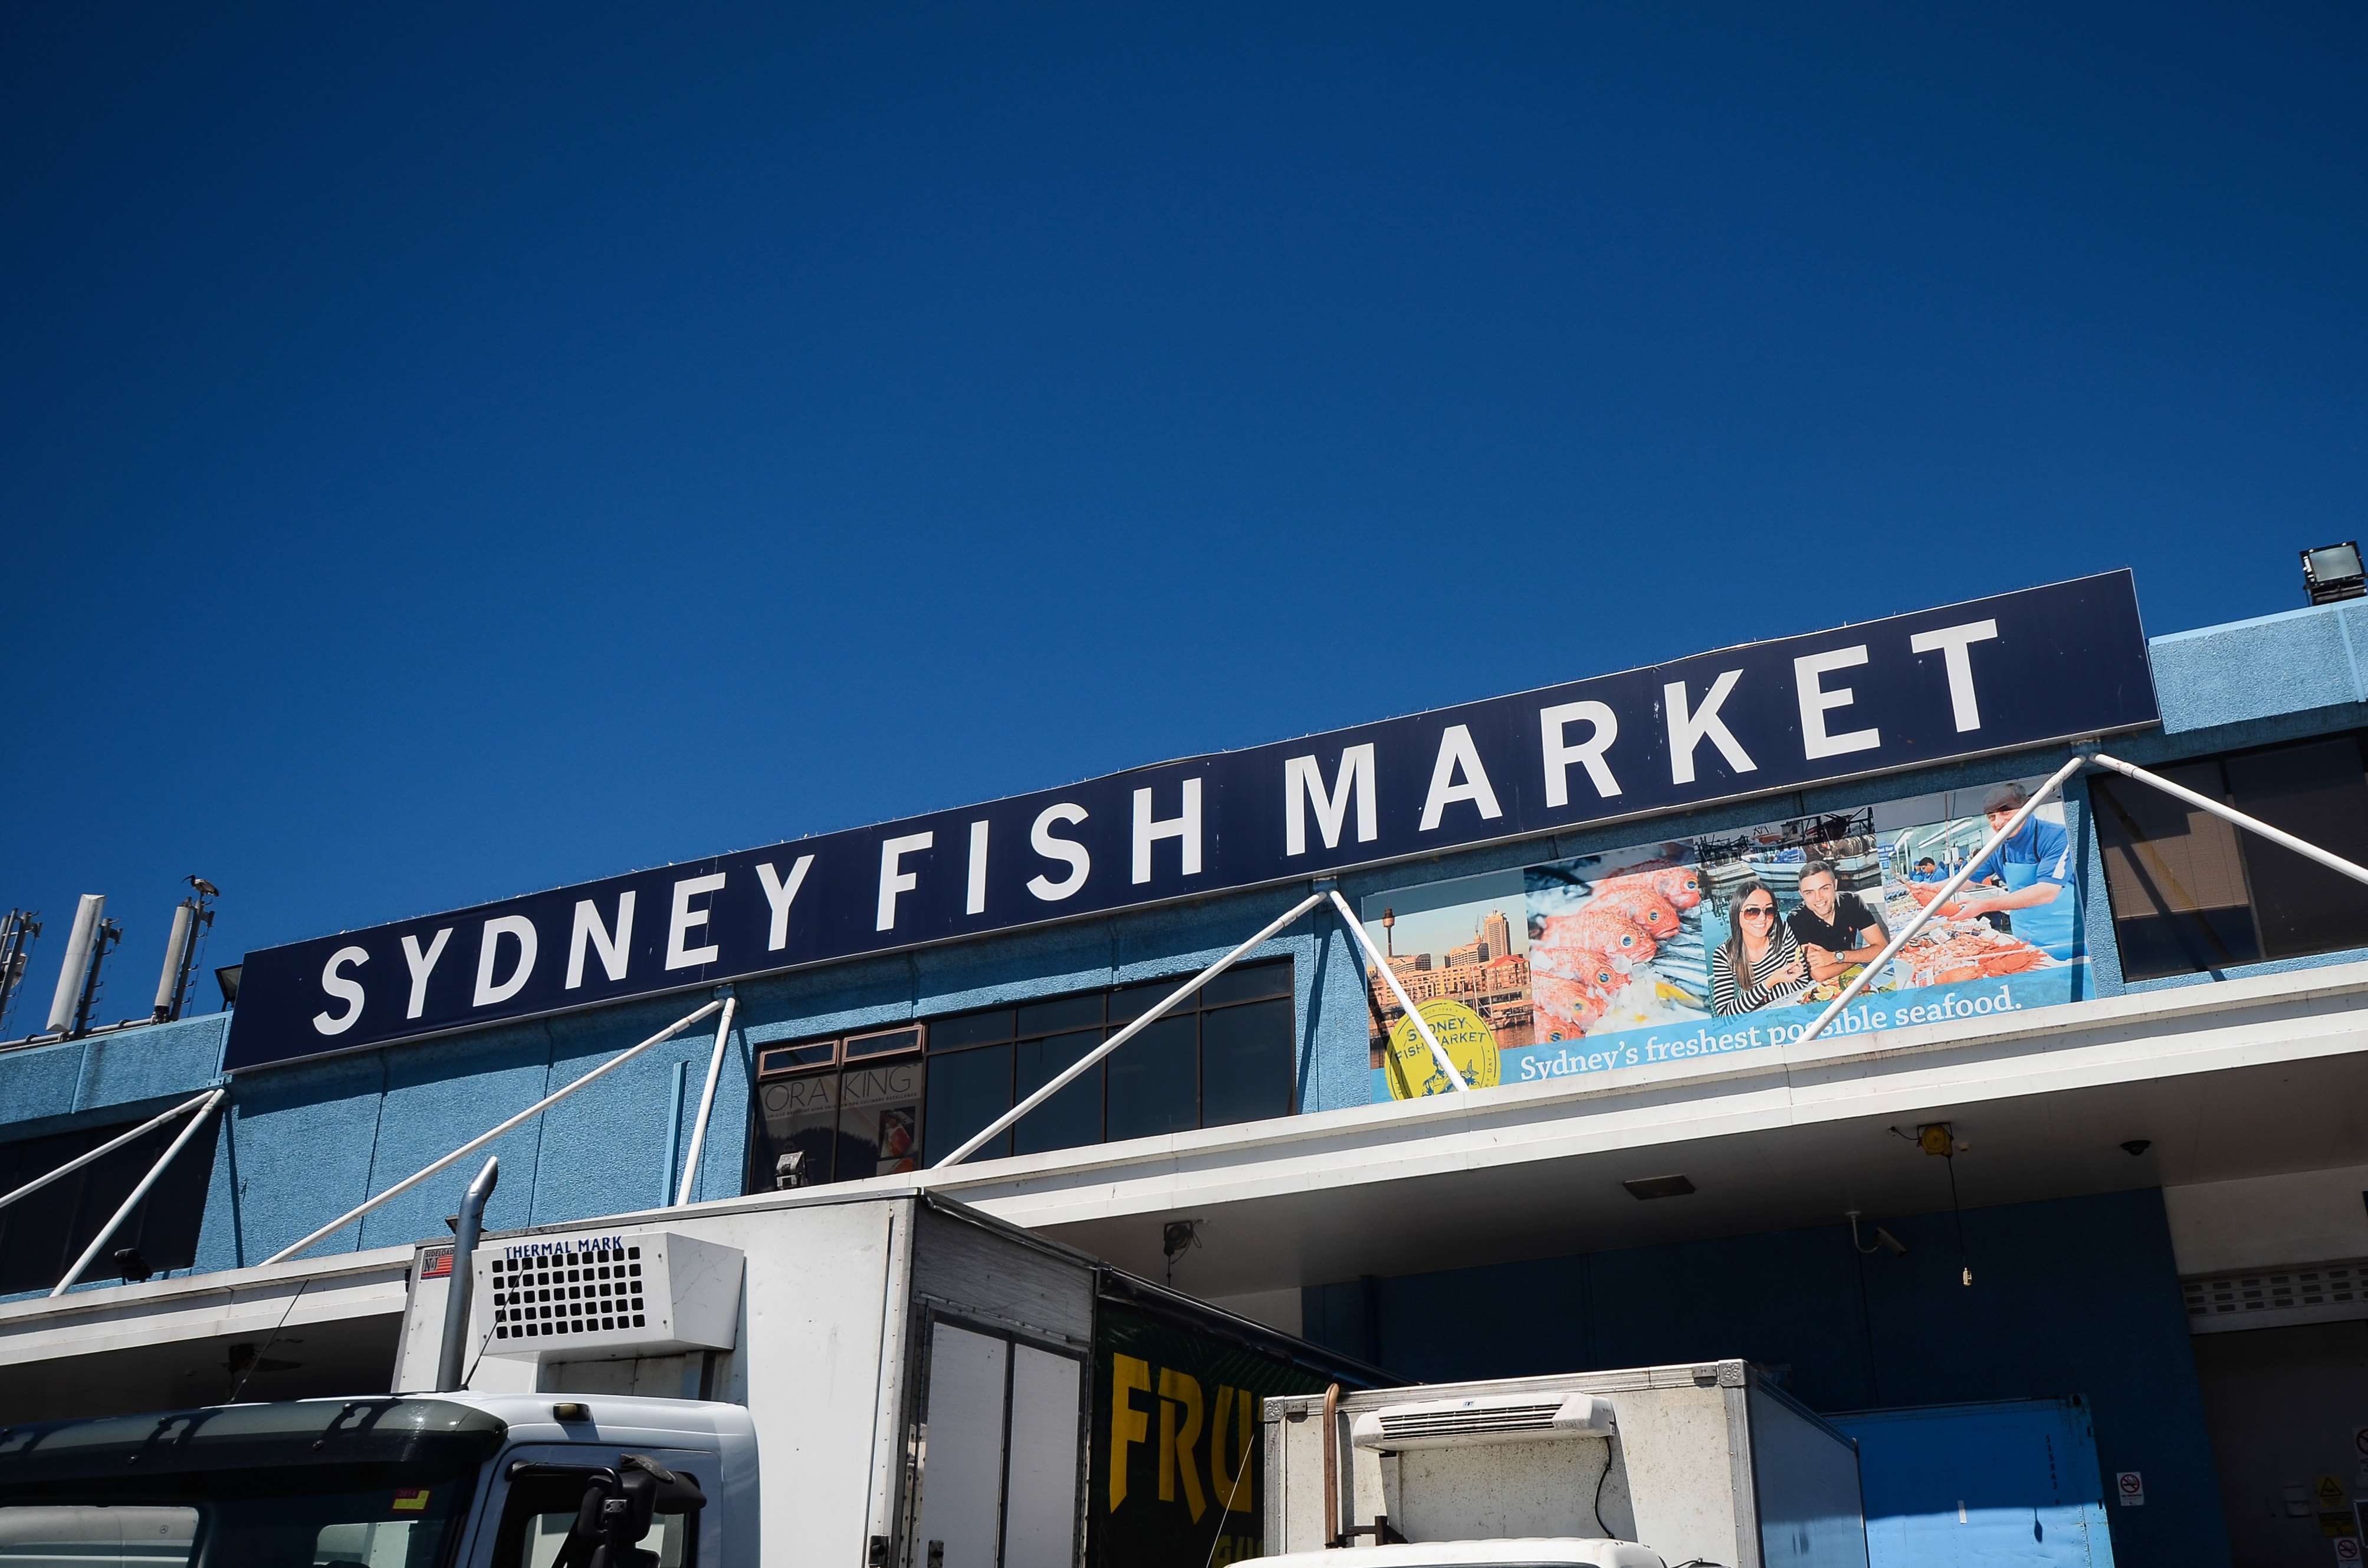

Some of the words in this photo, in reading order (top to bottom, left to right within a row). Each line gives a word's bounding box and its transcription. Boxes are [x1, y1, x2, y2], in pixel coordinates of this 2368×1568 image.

[313, 854, 816, 1036] SYDNEY
[876, 777, 1202, 931] FISH
[1285, 618, 1998, 856] MARKET
[1407, 1017, 1466, 1041] SDNEY
[1436, 1032, 1486, 1046] ARKET
[1645, 1025, 1762, 1062] freshest
[1894, 985, 2022, 1027] seafood.
[765, 1079, 829, 1112] ORA
[504, 1240, 572, 1260] THERMAL
[578, 1235, 624, 1253] MARK
[1109, 1352, 1265, 1526] FRU
[2045, 1435, 2058, 1490] 515843
